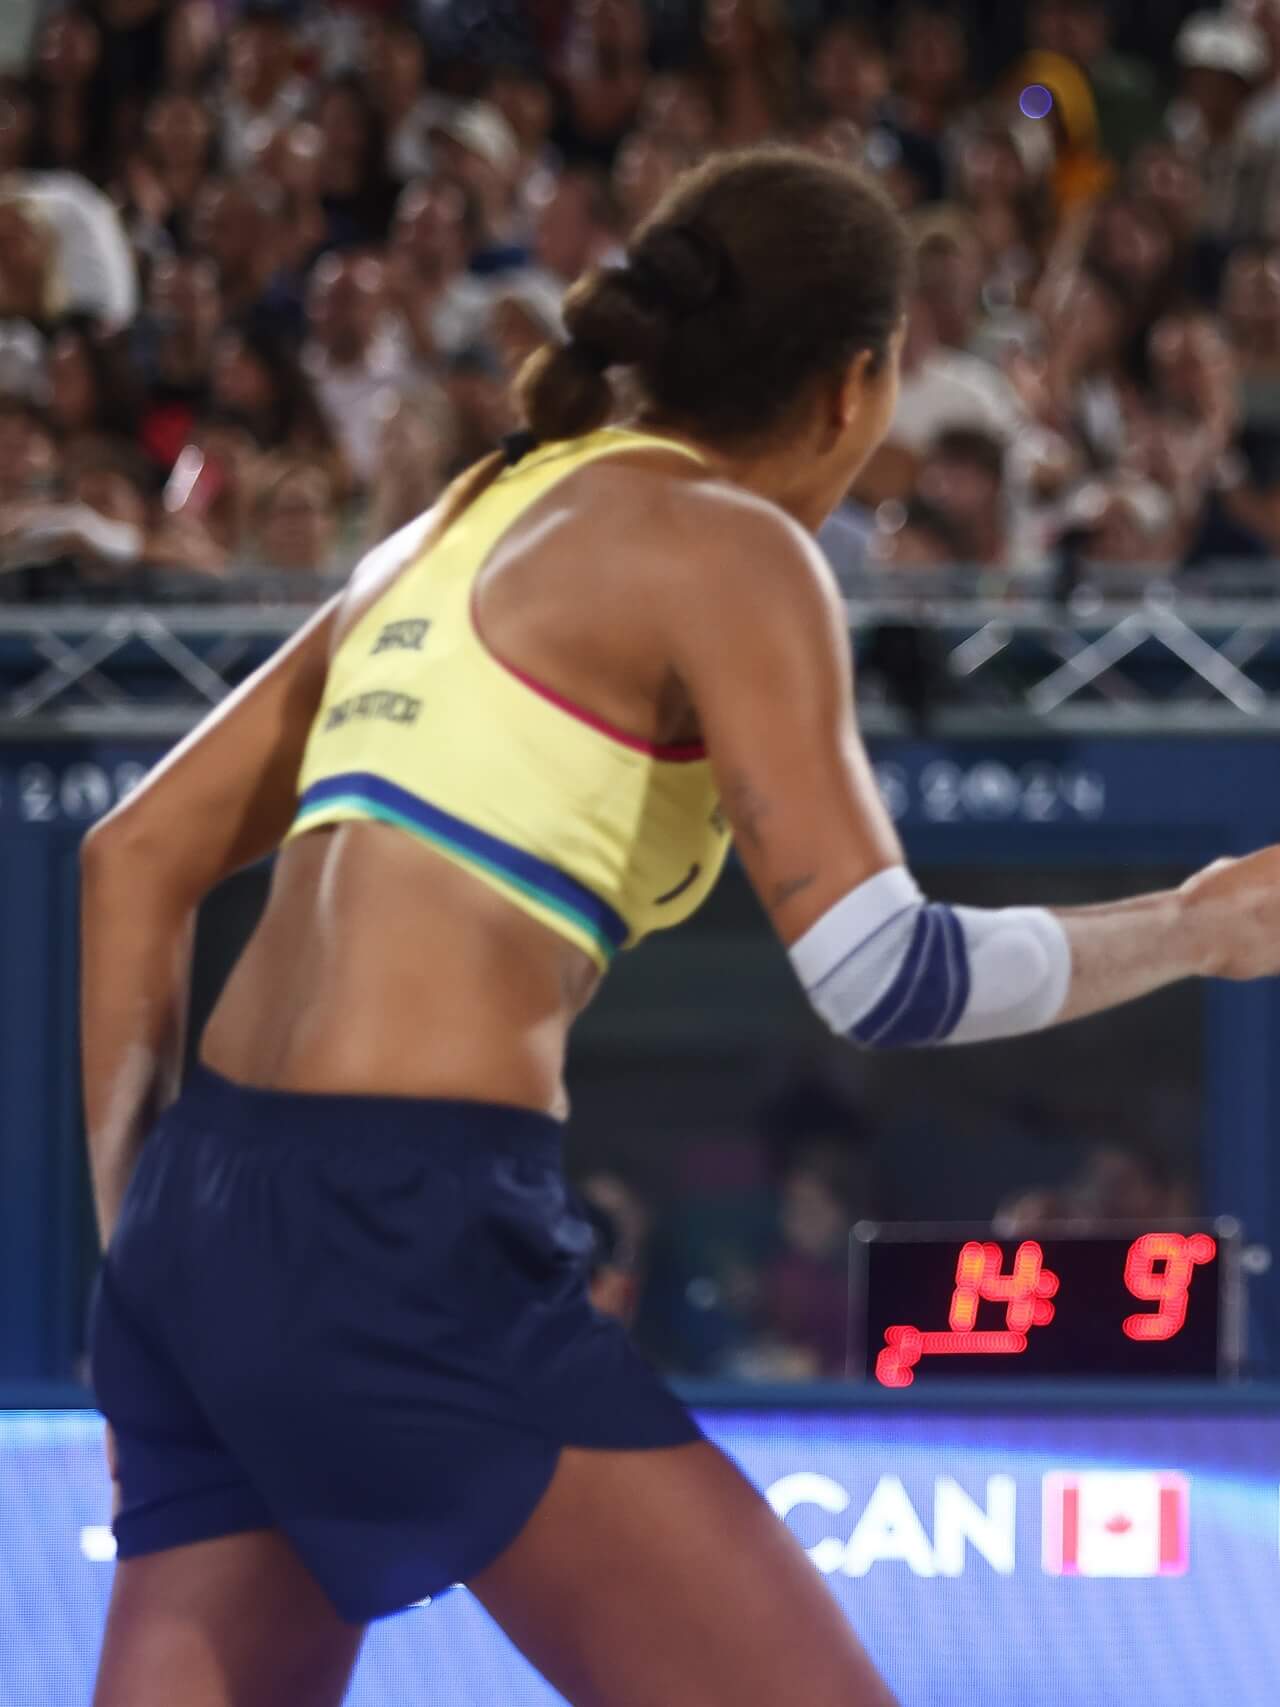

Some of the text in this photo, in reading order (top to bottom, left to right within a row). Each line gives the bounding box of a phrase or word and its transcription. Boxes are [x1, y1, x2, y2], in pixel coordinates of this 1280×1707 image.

[17, 761, 148, 822] 20
[919, 760, 1105, 822] 2024
[766, 1470, 1016, 1577] CAN
